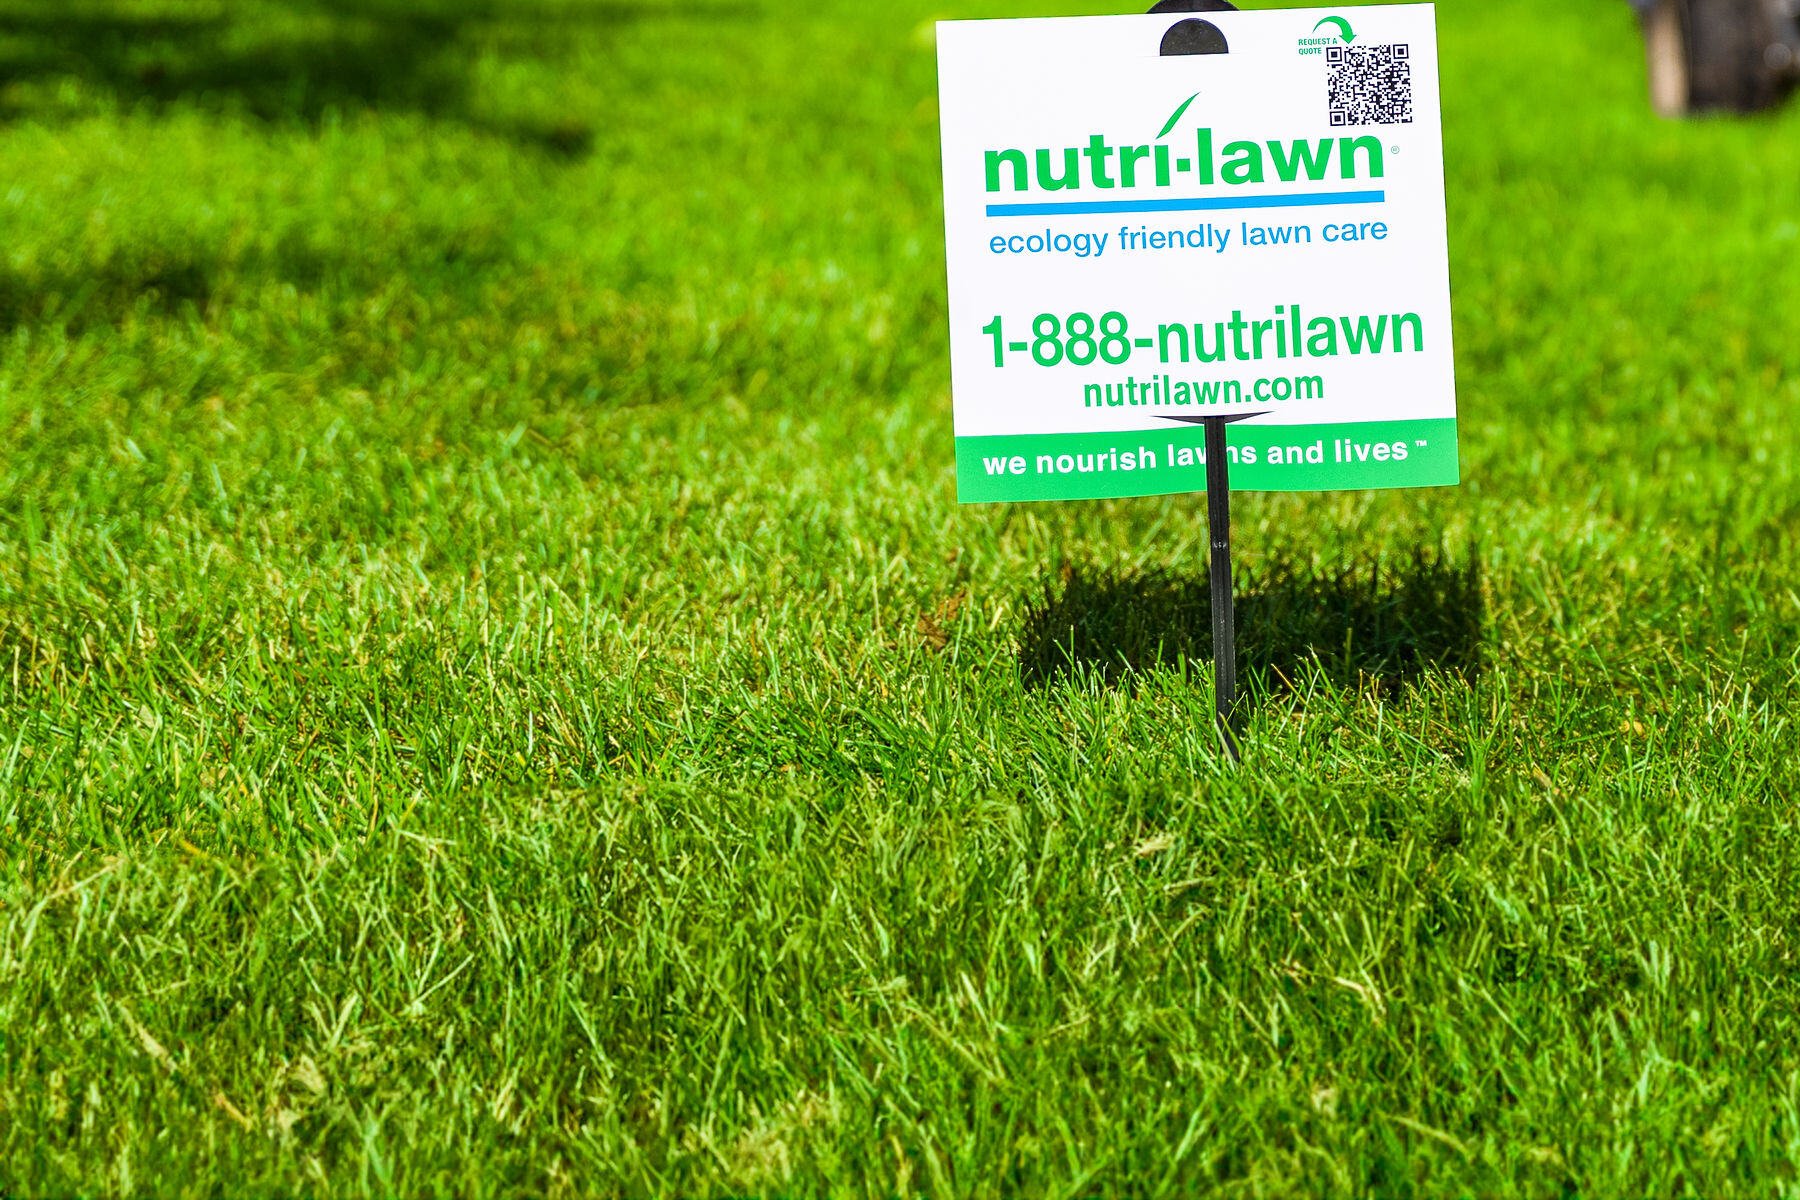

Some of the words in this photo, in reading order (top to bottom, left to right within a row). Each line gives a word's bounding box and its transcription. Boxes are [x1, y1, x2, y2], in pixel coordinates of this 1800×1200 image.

[1298, 37, 1330, 46] REQUEST
[1332, 37, 1338, 45] A
[1298, 47, 1322, 56] QUOTE
[989, 227, 1109, 258] ecology
[1118, 223, 1231, 254] friendly
[1241, 221, 1312, 246] lawn
[1321, 221, 1389, 243] care
[982, 303, 1424, 368] 1-888-nutrilawn
[1083, 374, 1324, 408] nutrilawn.com
[982, 455, 1027, 476] we
[1036, 446, 1157, 474] nourish
[1267, 439, 1324, 465] and
[1334, 438, 1409, 463] lives
